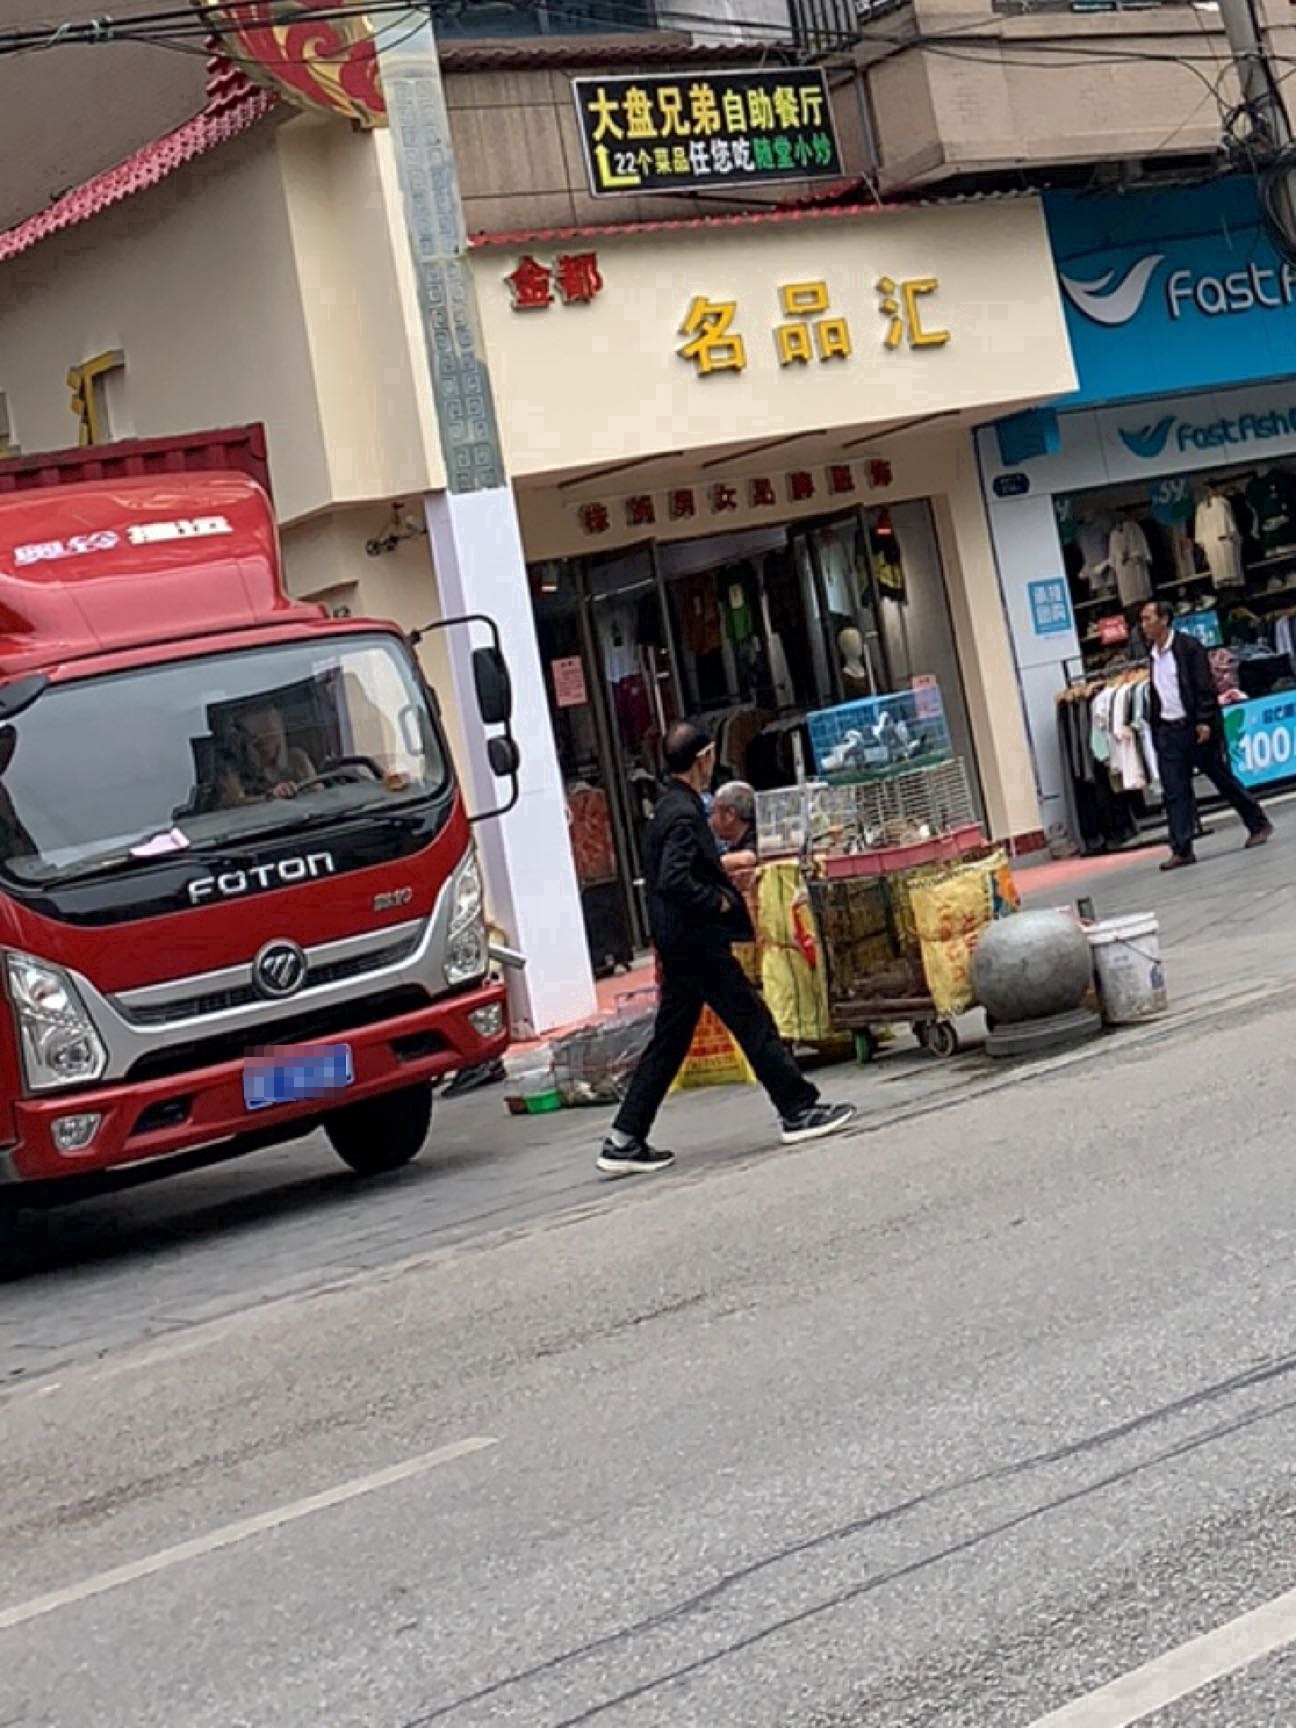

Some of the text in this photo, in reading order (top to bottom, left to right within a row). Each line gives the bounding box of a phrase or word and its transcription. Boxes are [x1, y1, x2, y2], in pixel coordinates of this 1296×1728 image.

[587, 82, 823, 142] 大盘兄弟自助餐厅
[503, 250, 604, 311] 金都
[676, 275, 951, 376] 名品汇
[187, 851, 335, 905] FOTON
